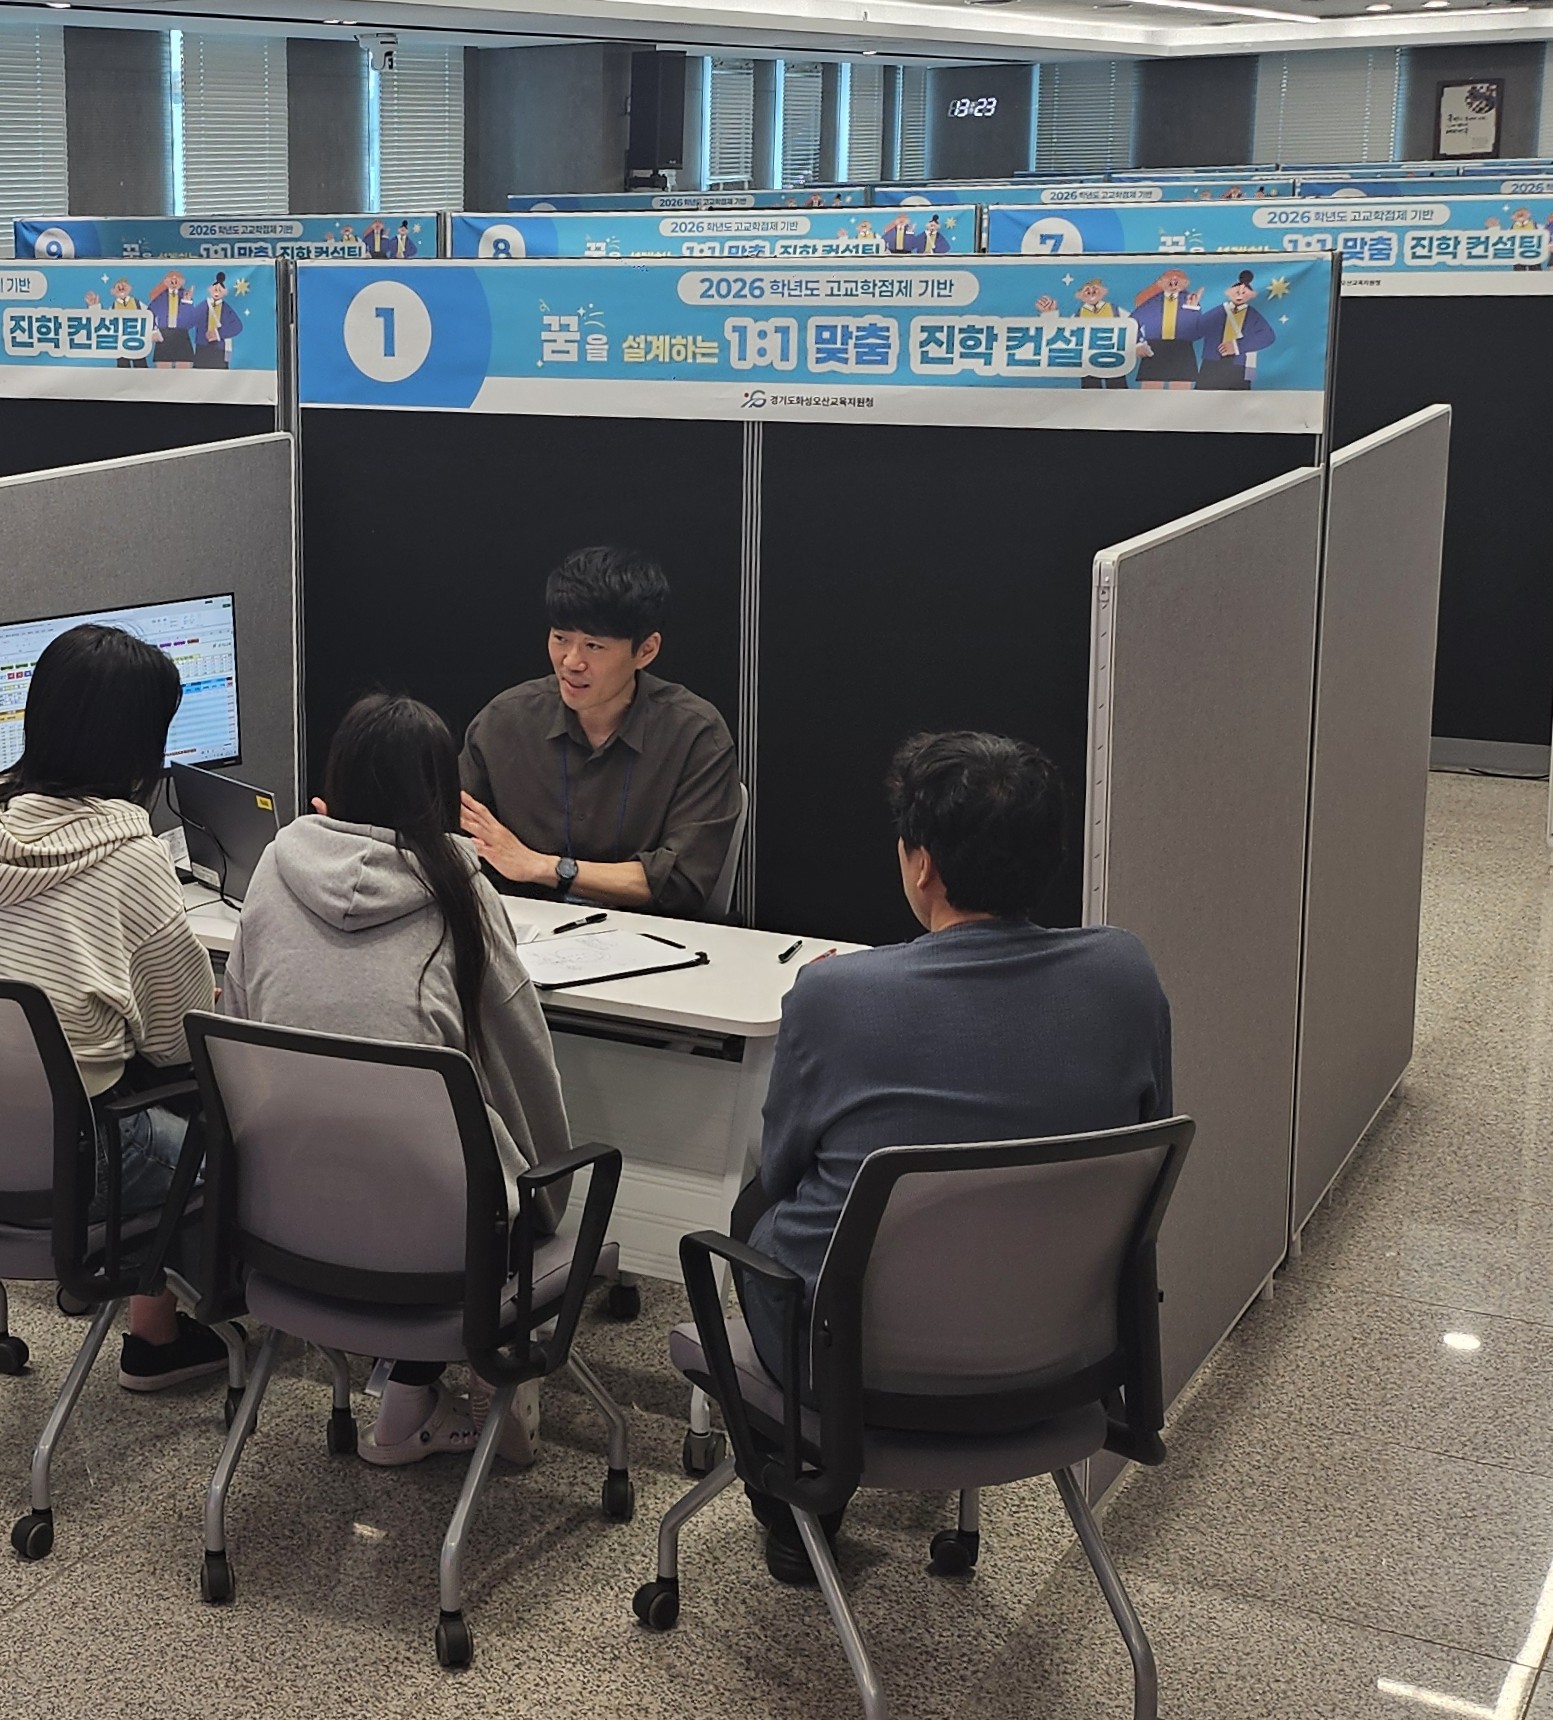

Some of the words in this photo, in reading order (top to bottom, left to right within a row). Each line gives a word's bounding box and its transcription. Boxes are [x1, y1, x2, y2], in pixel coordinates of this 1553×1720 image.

[951, 97, 997, 117] 13:23
[660, 198, 683, 208] 2026
[1050, 190, 1078, 200] 2026
[1267, 211, 1311, 224] 2026
[1314, 210, 1347, 224] 학년도
[1351, 210, 1408, 222] 고교학점제
[1410, 209, 1434, 221] 기반
[188, 224, 217, 236] 2026
[218, 225, 240, 235] 학년도
[278, 224, 294, 234] 기반
[670, 221, 704, 234] 2026
[706, 222, 732, 232] 학년도
[734, 221, 778, 232] 고교학점제
[780, 220, 798, 232] 기반
[46, 240, 62, 258] 9
[492, 238, 510, 258] 8
[1040, 233, 1064, 253] 7
[1342, 236, 1393, 261] 맞춤
[1410, 236, 1462, 260] 진학
[1466, 234, 1543, 260] 컨설팅
[7, 278, 31, 294] 기반
[698, 277, 766, 300] 2026
[769, 278, 821, 299] 학년도
[825, 278, 914, 300] 고교학점제
[917, 279, 954, 300] 기반
[9, 314, 64, 350] 진학
[66, 315, 147, 352] 컨설팅
[374, 306, 397, 358] 1
[540, 315, 610, 362] 꿈을
[621, 334, 720, 364] 설계하는
[730, 324, 793, 364] 1:1
[814, 322, 893, 369] 맞춤
[918, 324, 999, 368] 진학
[1005, 324, 1128, 370] 컨설팅
[769, 394, 875, 408] 경기도화성오산교육지원청
